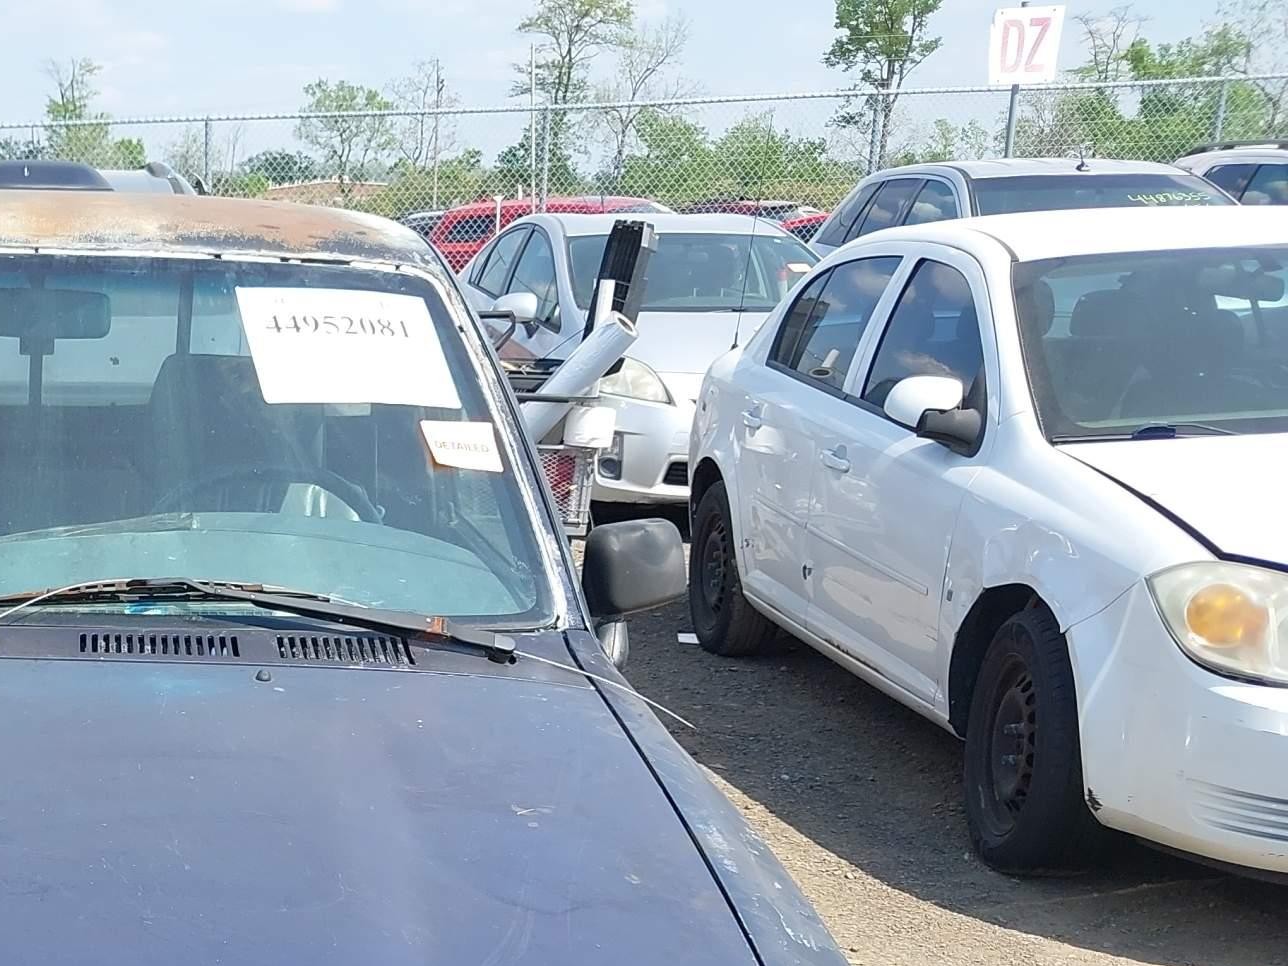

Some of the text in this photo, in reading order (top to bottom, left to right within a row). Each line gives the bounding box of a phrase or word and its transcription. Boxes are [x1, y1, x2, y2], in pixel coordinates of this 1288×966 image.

[1000, 17, 1052, 73] DZ
[266, 315, 409, 338] 44952081
[434, 440, 490, 453] DETAILED
